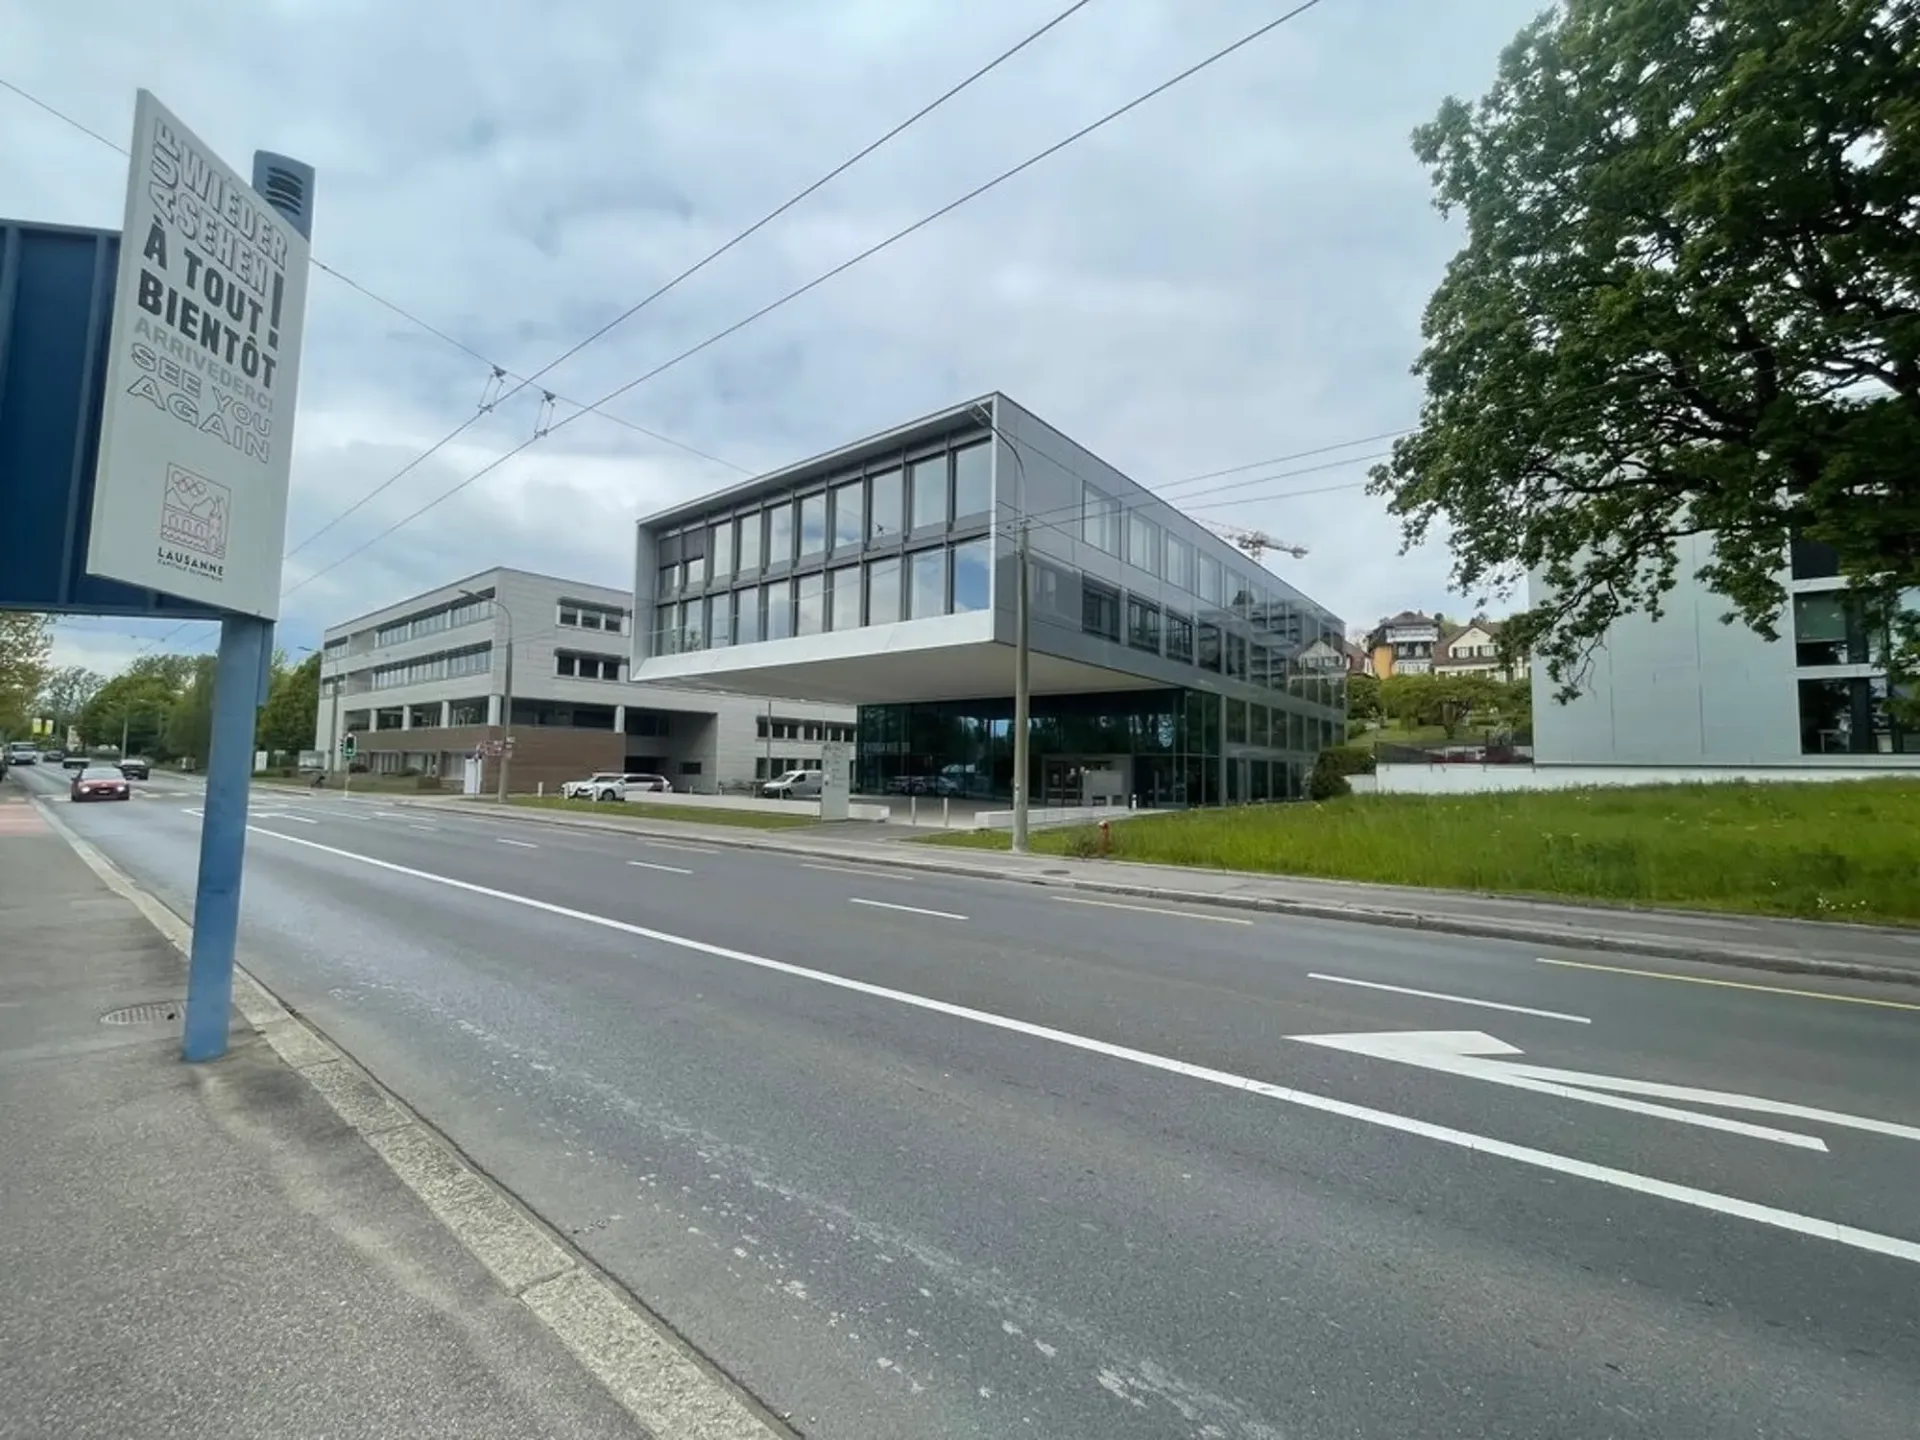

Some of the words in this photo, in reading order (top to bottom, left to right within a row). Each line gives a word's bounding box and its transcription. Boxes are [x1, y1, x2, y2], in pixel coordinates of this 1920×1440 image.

[149, 117, 181, 225] AUF
[181, 142, 287, 271] WIEDER
[143, 214, 167, 270] À
[184, 247, 263, 335] TOUT
[176, 193, 268, 297] SEHEN
[135, 317, 273, 413] ARRIVEDERCI
[138, 268, 276, 389] BIENTÔT
[127, 375, 269, 464] AGAIN
[131, 342, 202, 398] SEE
[211, 385, 271, 437] YOU
[158, 546, 223, 577] LAUSANNE
